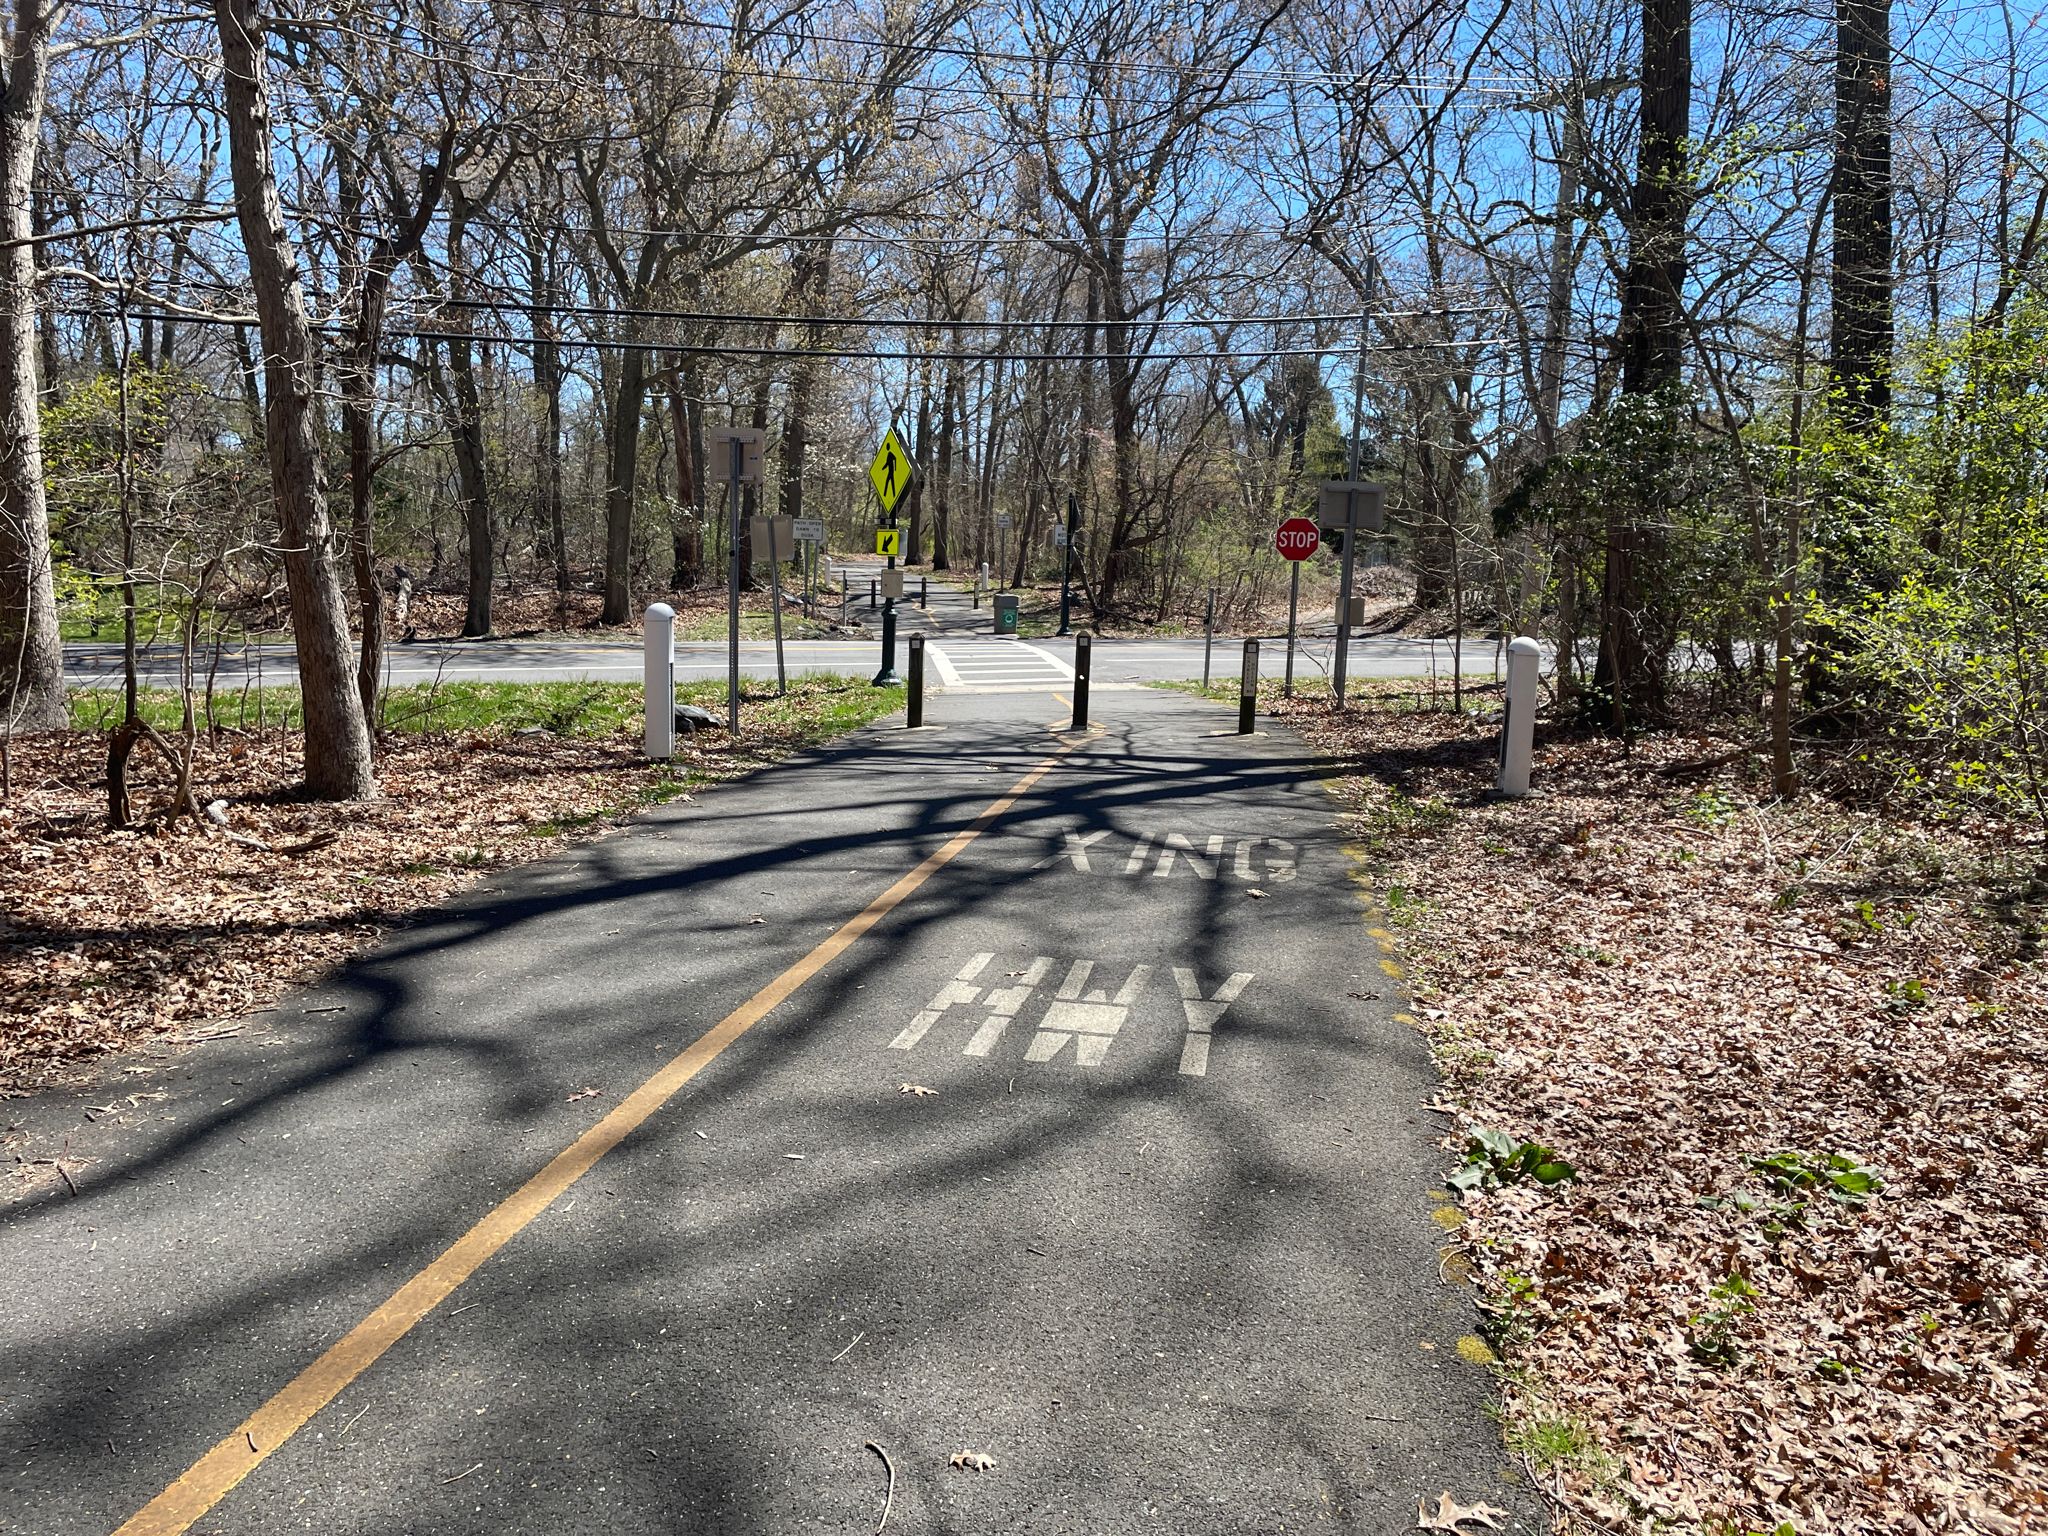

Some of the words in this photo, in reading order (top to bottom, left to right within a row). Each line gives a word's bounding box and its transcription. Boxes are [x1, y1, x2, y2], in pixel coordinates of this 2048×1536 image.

[1278, 531, 1317, 548] STOP
[1030, 826, 1297, 882] XING
[888, 952, 1256, 1076] HWY
